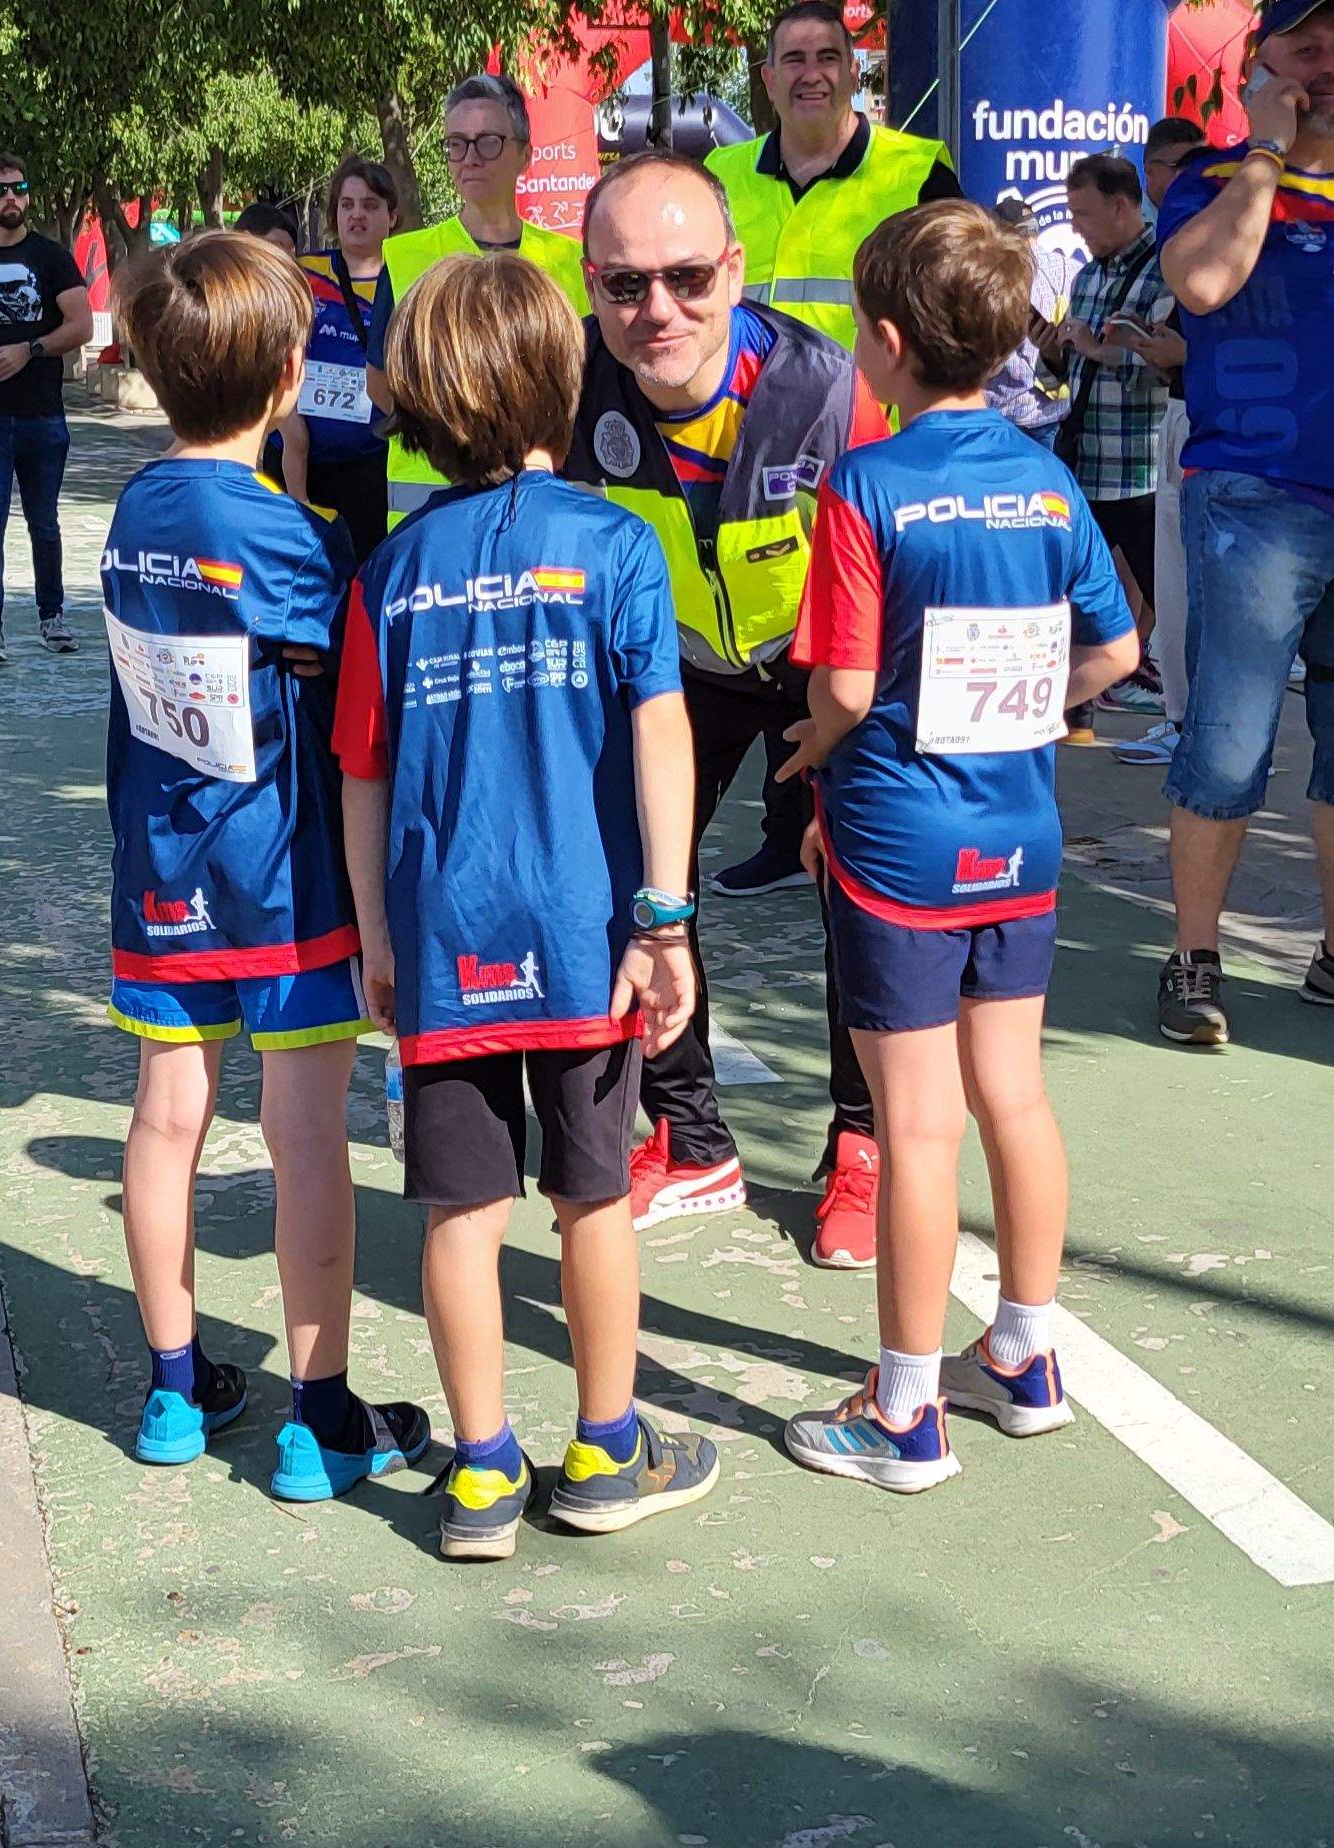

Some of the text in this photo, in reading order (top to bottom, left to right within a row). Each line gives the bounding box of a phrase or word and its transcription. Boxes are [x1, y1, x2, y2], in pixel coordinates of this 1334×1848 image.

[973, 99, 1149, 144] fundación
[531, 143, 577, 165] ports
[340, 331, 359, 342] mup
[313, 388, 356, 411] 672
[893, 493, 1050, 532] POLICIA
[986, 516, 1073, 532] NACIONAL
[140, 574, 239, 600] NACIONAL
[386, 571, 540, 626] POLICIA
[468, 592, 584, 613] NACIONAL
[966, 677, 1053, 723] 749
[138, 685, 210, 748] 750
[147, 921, 208, 937] SOLIDARIOS
[463, 988, 535, 1006] SOLIDARIOS
